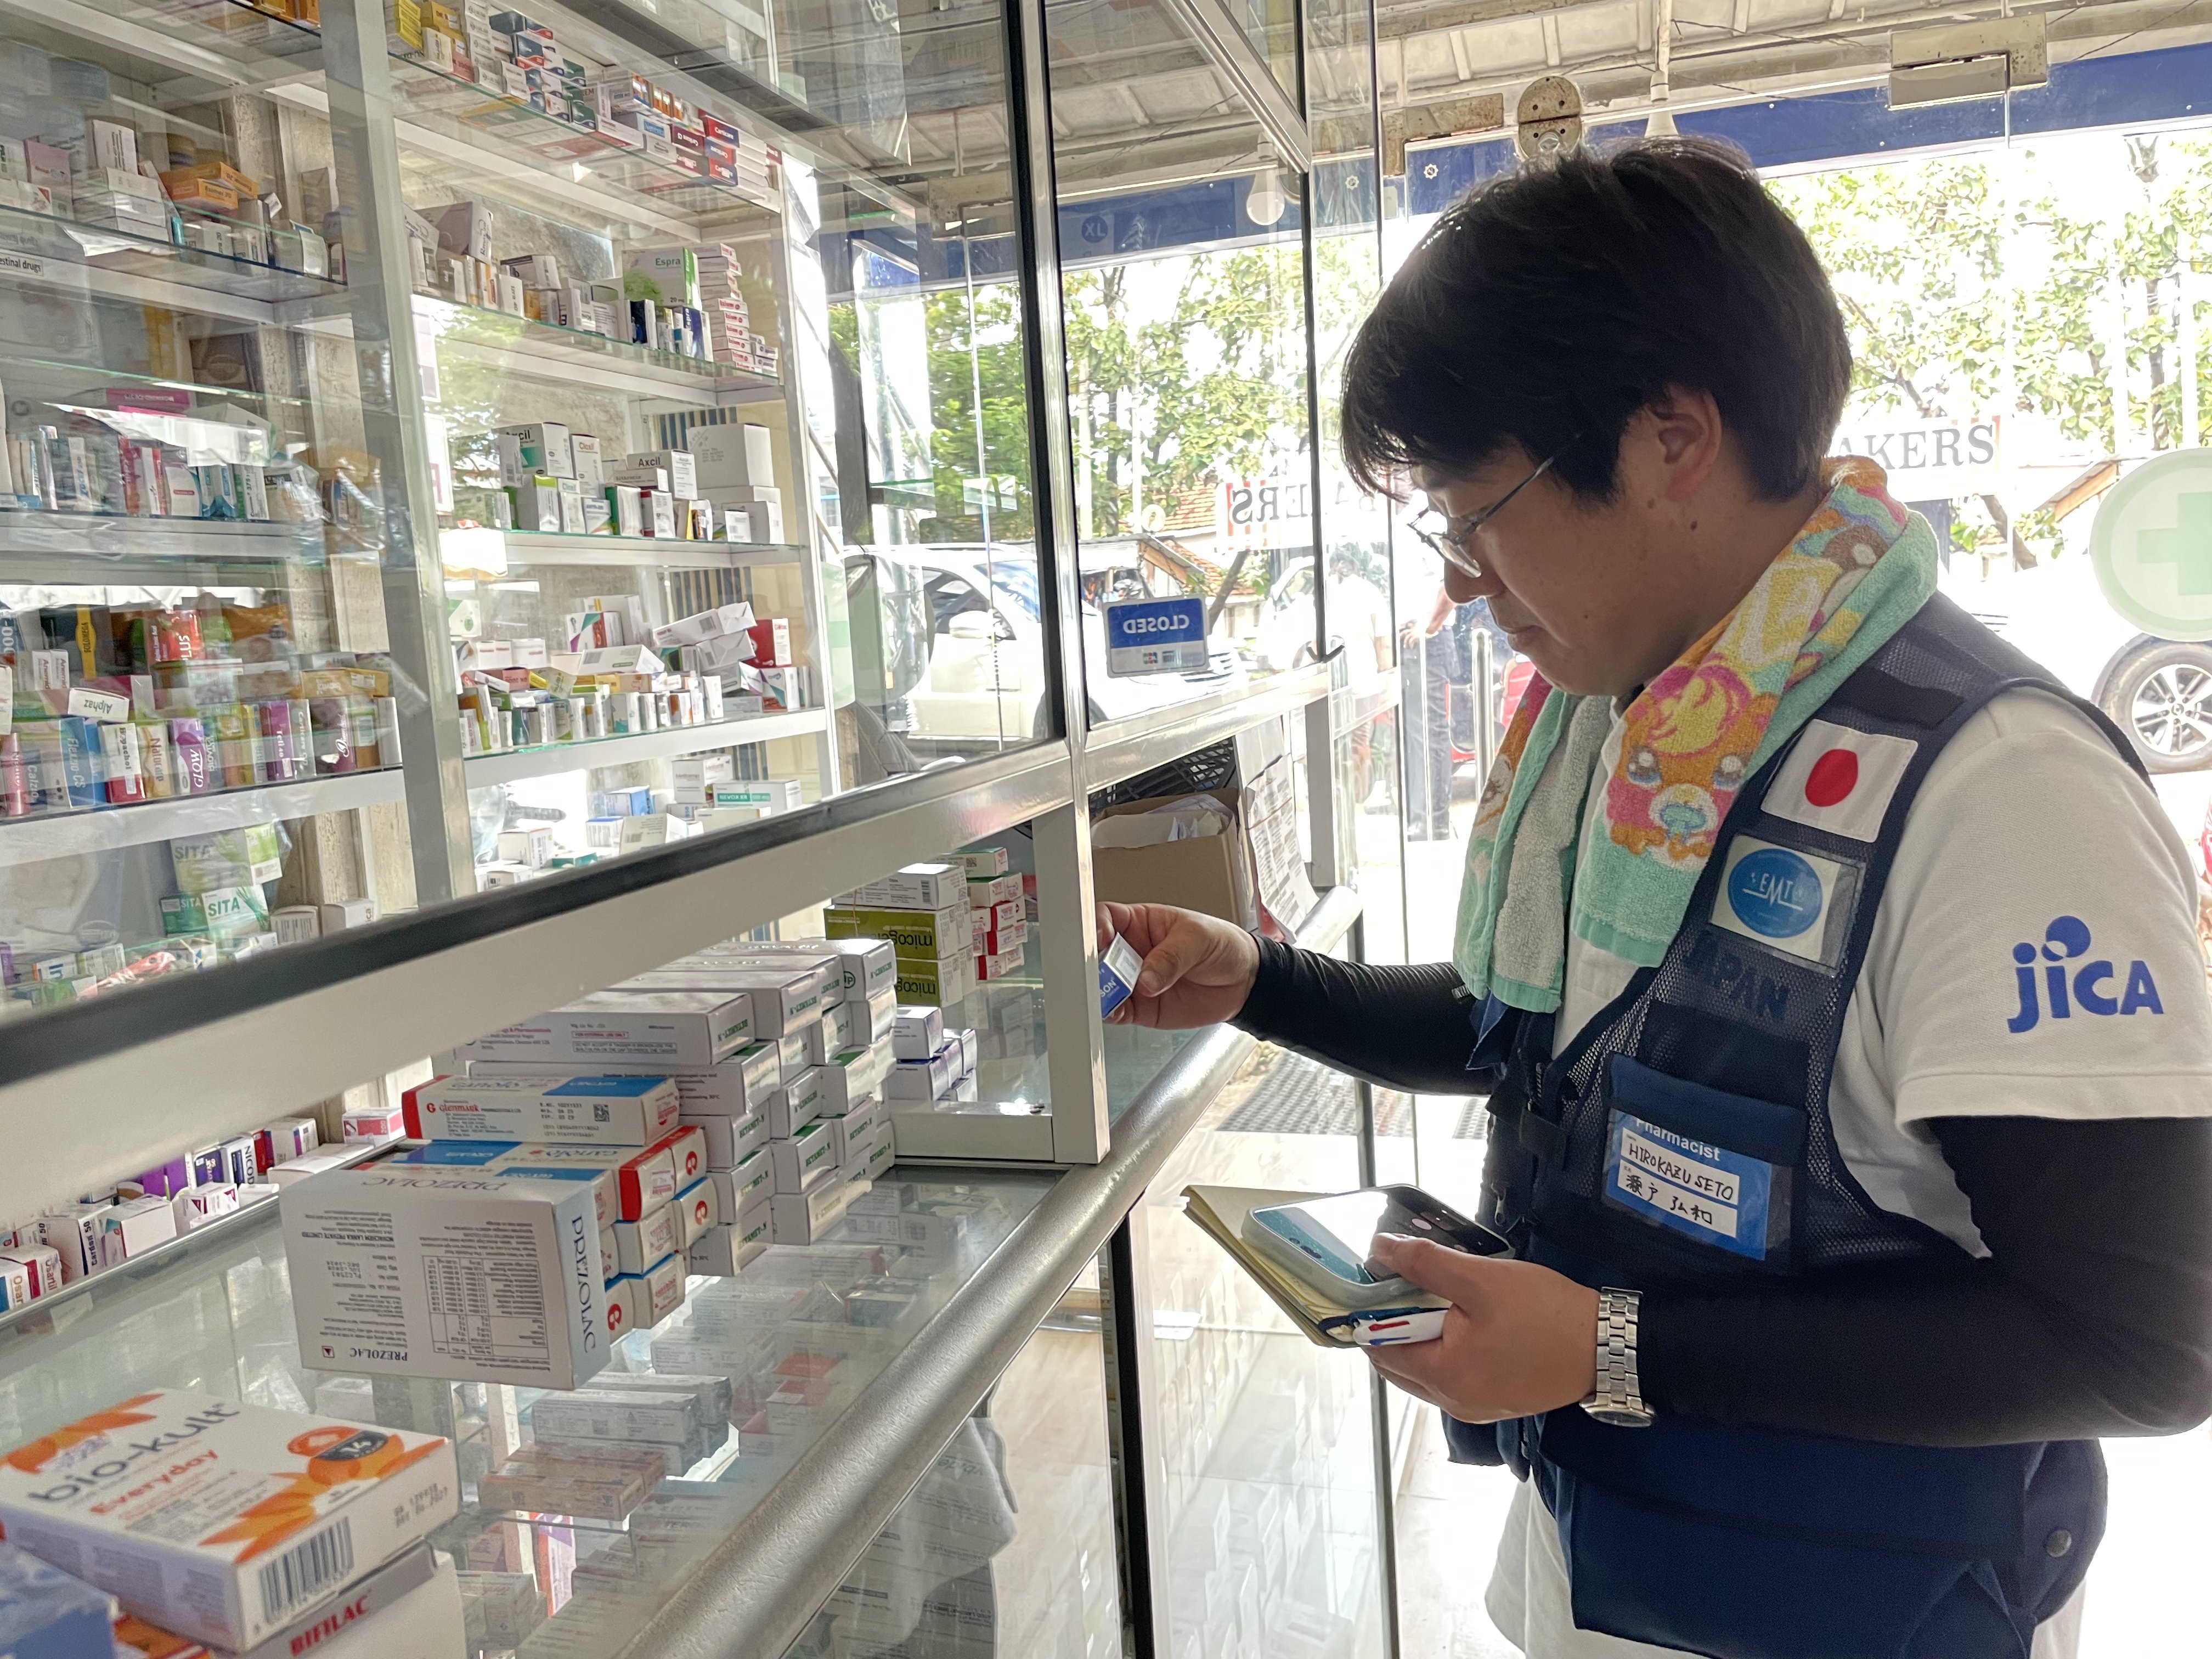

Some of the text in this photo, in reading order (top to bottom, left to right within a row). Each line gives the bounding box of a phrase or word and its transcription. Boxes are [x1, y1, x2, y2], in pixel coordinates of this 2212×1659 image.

[1085, 222, 1107, 236] XL
[22, 260, 41, 272] drugs
[655, 257, 681, 266] Espra
[506, 428, 531, 440] cil
[638, 456, 661, 466] Axcil
[83, 699, 113, 714] Alphaz
[180, 896, 201, 909] SITA
[207, 898, 240, 917] SITA
[1629, 1143, 1734, 1200] HIROKAZU SETO
[83, 1221, 92, 1233] 50
[571, 1215, 597, 1355] PREZOLAC
[349, 1347, 408, 1362] PREZOLAC
[27, 1402, 241, 1504] bio-kult
[89, 1449, 218, 1515] Everyday
[289, 1595, 371, 1657] BIFILAC
